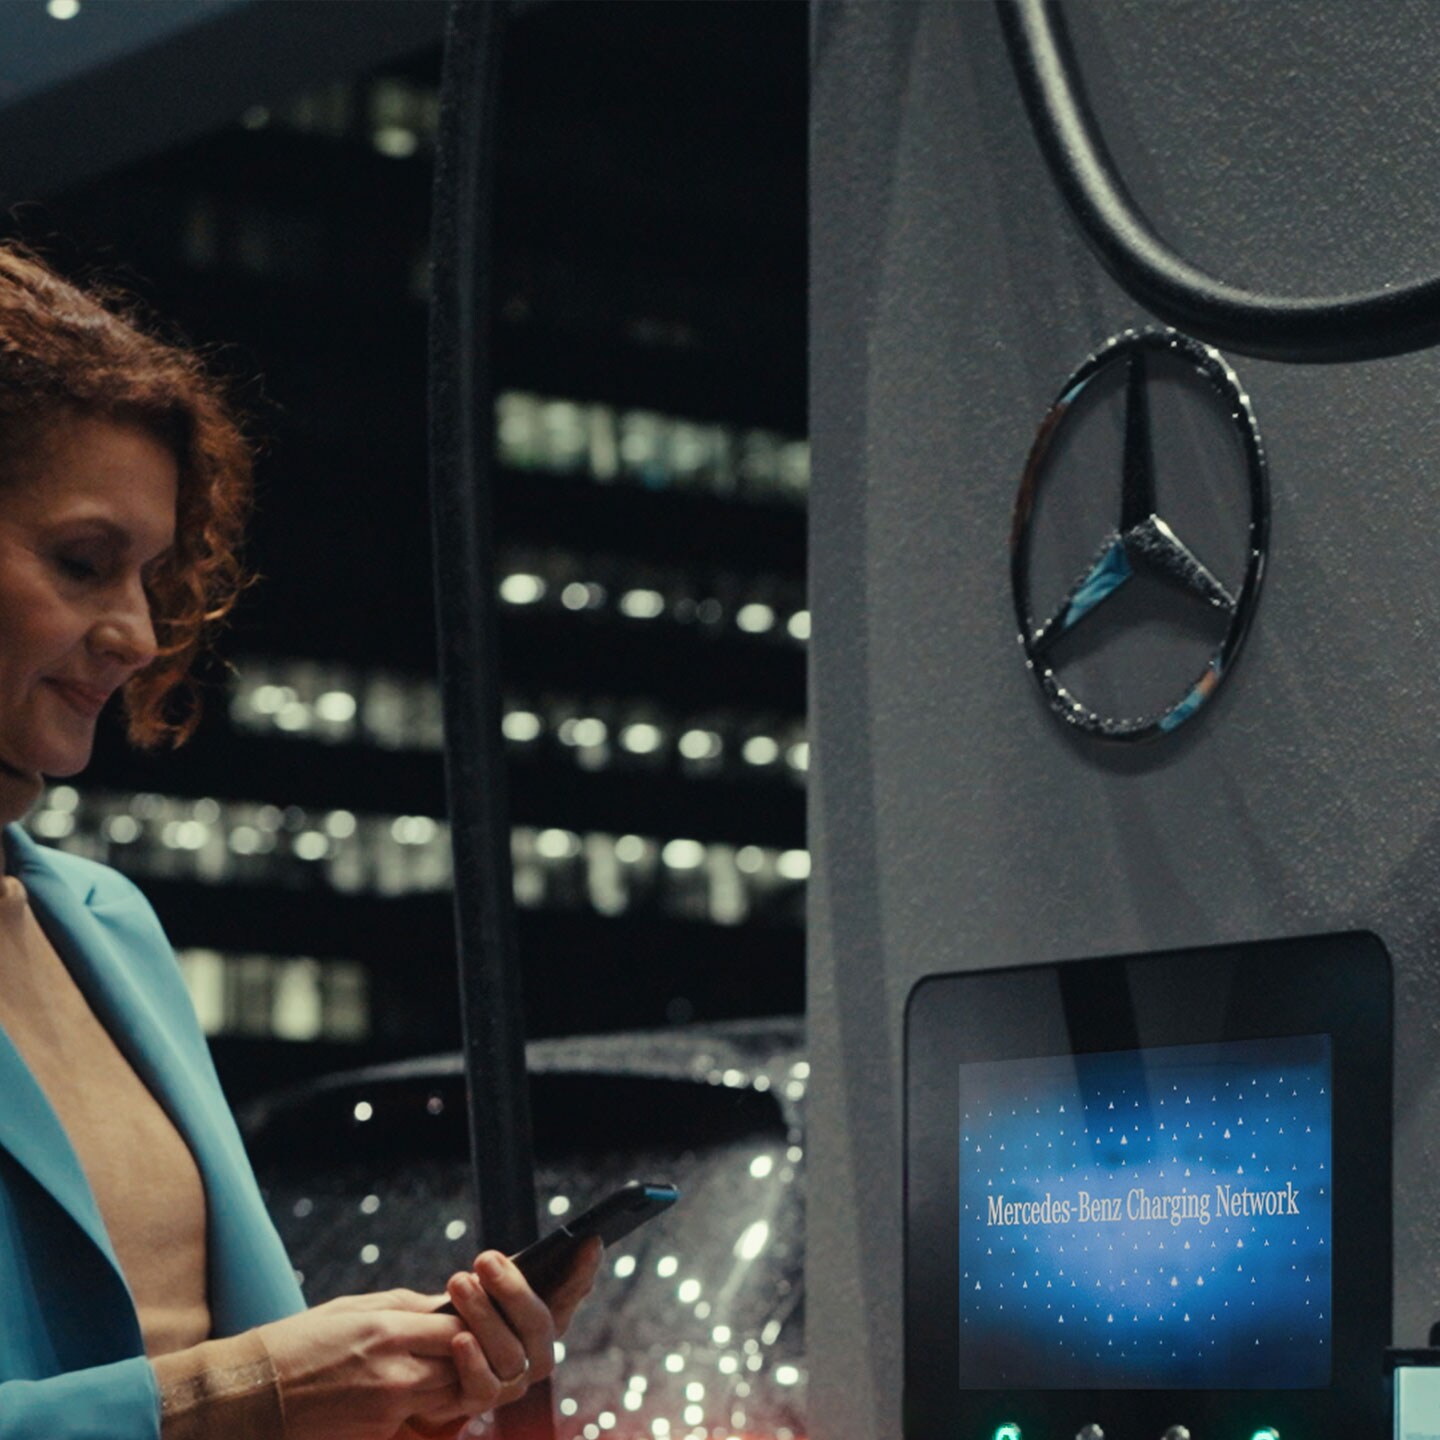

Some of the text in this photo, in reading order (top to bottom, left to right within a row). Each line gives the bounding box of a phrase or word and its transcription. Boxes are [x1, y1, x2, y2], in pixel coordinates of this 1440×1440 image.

[987, 1181, 1300, 1226] Mercedes-Benz Charging Network
